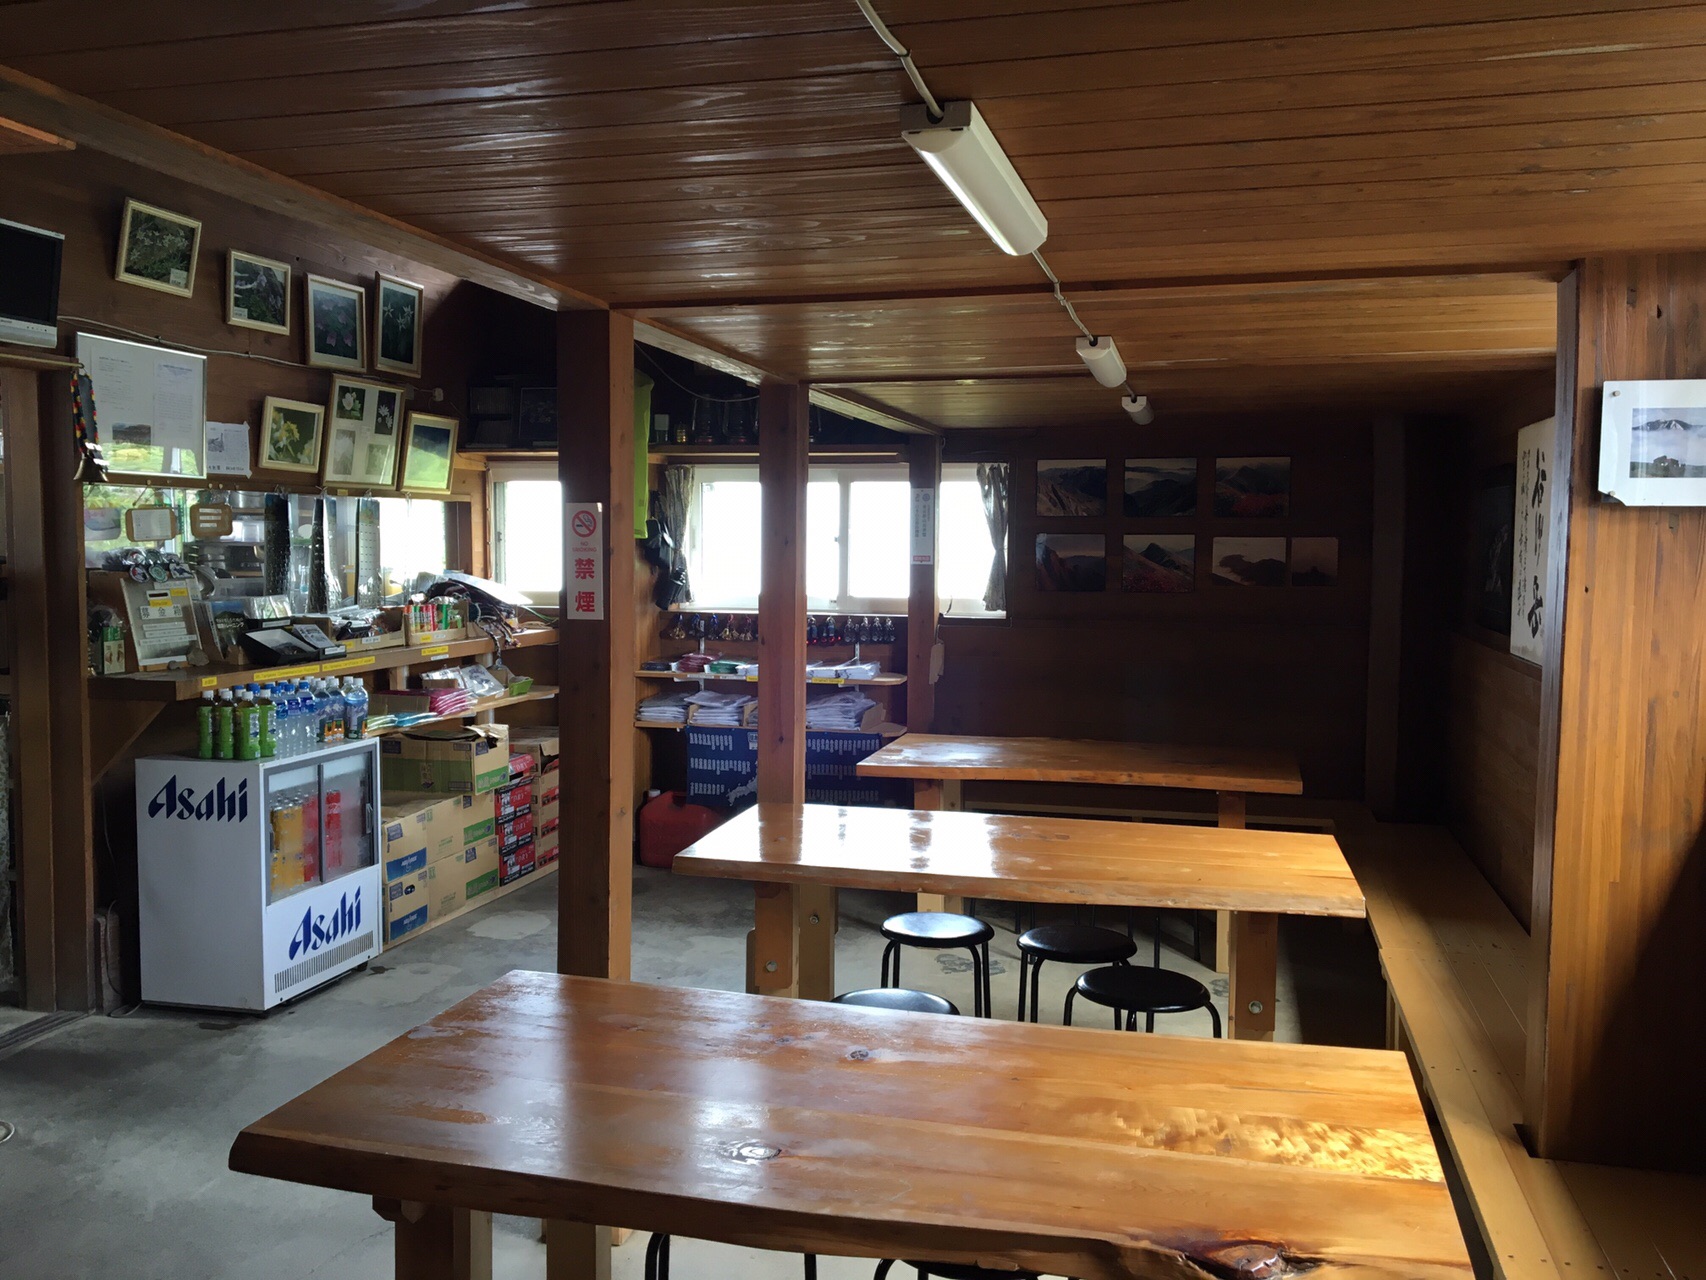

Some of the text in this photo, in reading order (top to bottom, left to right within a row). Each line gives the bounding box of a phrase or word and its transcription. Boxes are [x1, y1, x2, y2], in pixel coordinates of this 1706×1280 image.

[575, 558, 595, 612] 禁煙
[147, 774, 249, 823] Asahi
[288, 885, 362, 961] Asahi
